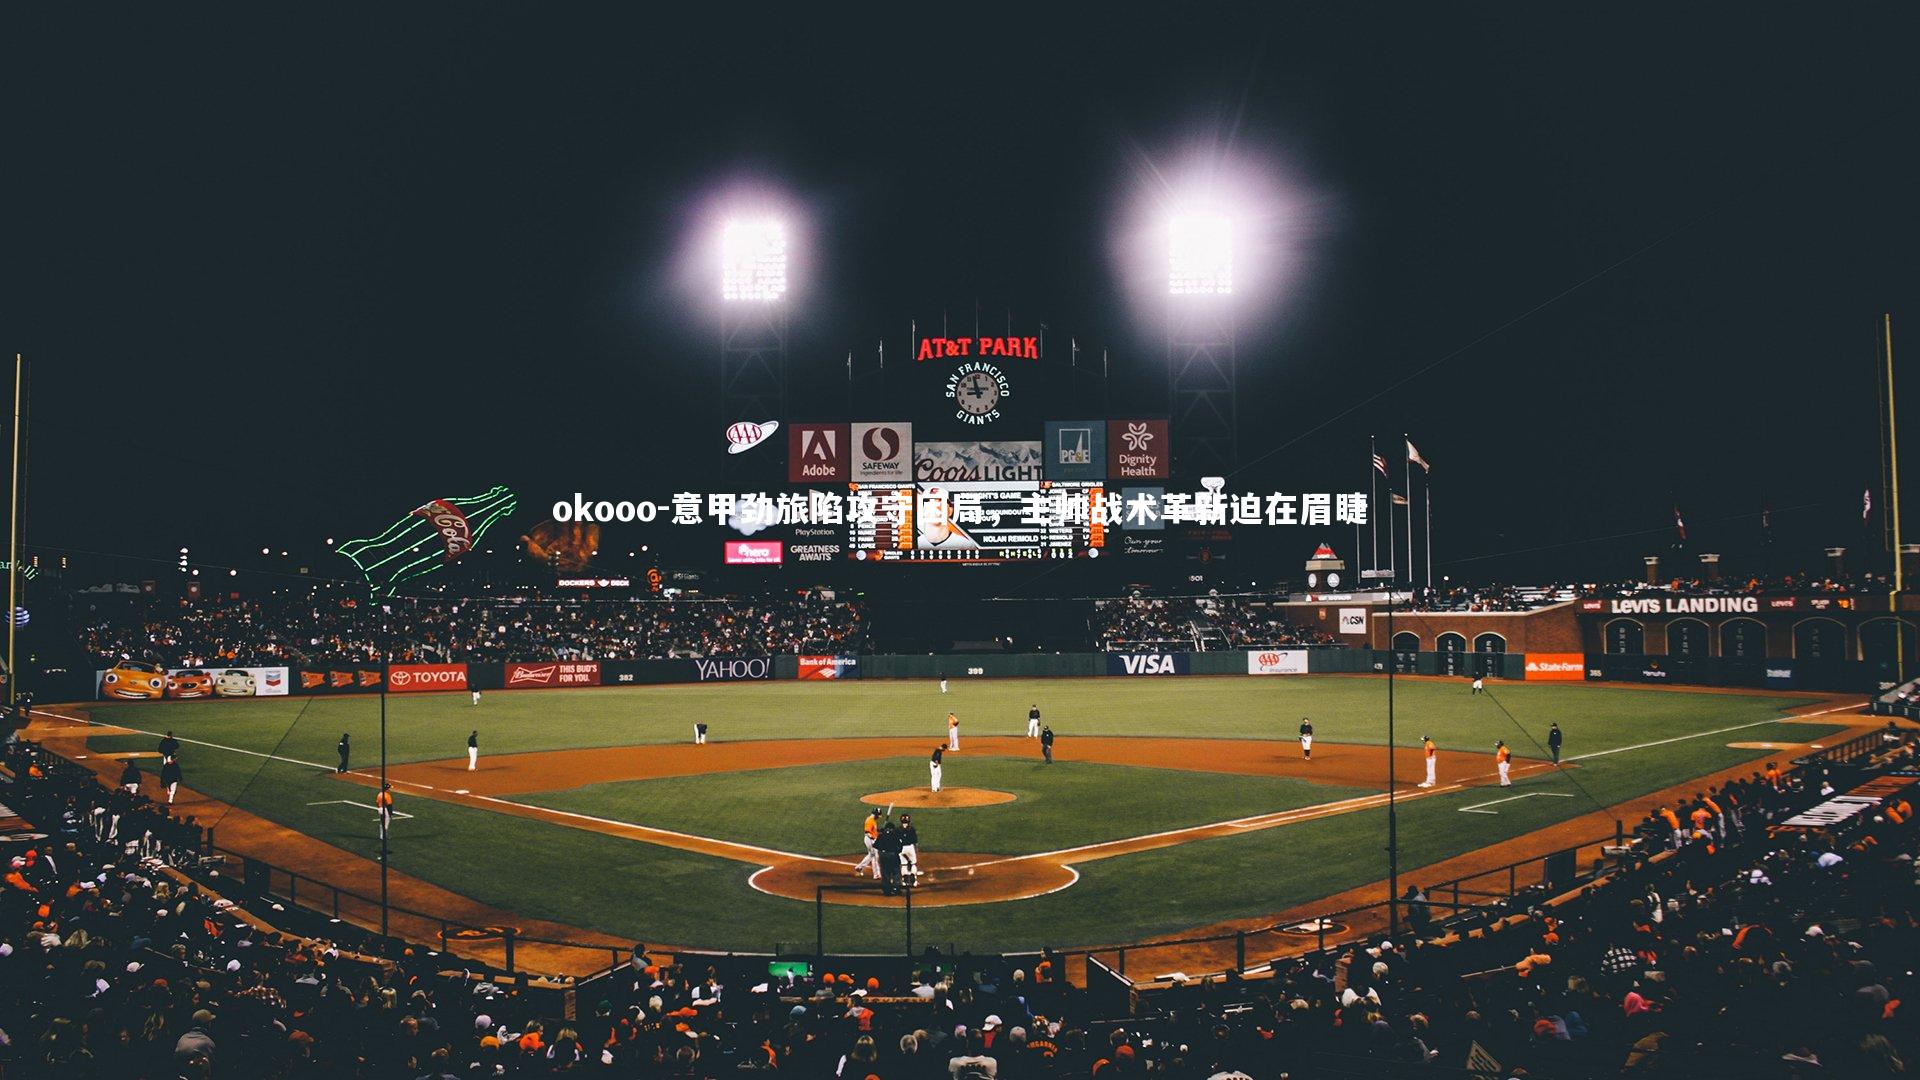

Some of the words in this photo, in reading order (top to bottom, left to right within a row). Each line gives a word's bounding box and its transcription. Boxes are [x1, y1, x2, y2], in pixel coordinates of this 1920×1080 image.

[917, 337, 972, 360] AT&T
[979, 337, 1038, 359] PARK
[946, 374, 959, 398] SAN
[958, 362, 1009, 397] FRANCISCO
[956, 409, 1000, 425] GIANTS
[1119, 454, 1157, 466] Dignity
[802, 464, 836, 476] Adobe
[862, 462, 900, 470] SAFEWAY
[916, 459, 982, 481] Coors
[984, 466, 1043, 481] LIGHT
[1121, 466, 1156, 476] Health
[795, 528, 835, 537] PlayStation
[790, 545, 839, 553] GREATNESS
[799, 553, 832, 561] AWAITS
[1665, 597, 1758, 613] LANDING
[1350, 616, 1364, 625] CSN
[800, 658, 818, 666] Bank
[818, 658, 826, 666] of
[826, 658, 856, 666] America
[1119, 655, 1175, 674] VISA
[559, 665, 575, 673] THIS
[576, 664, 598, 673] BUD'S
[695, 658, 770, 680] YAHOO!
[413, 671, 466, 683] TOYOTA
[515, 670, 551, 679] Budweiser
[559, 674, 574, 682] FOR
[575, 674, 590, 682] YOU.
